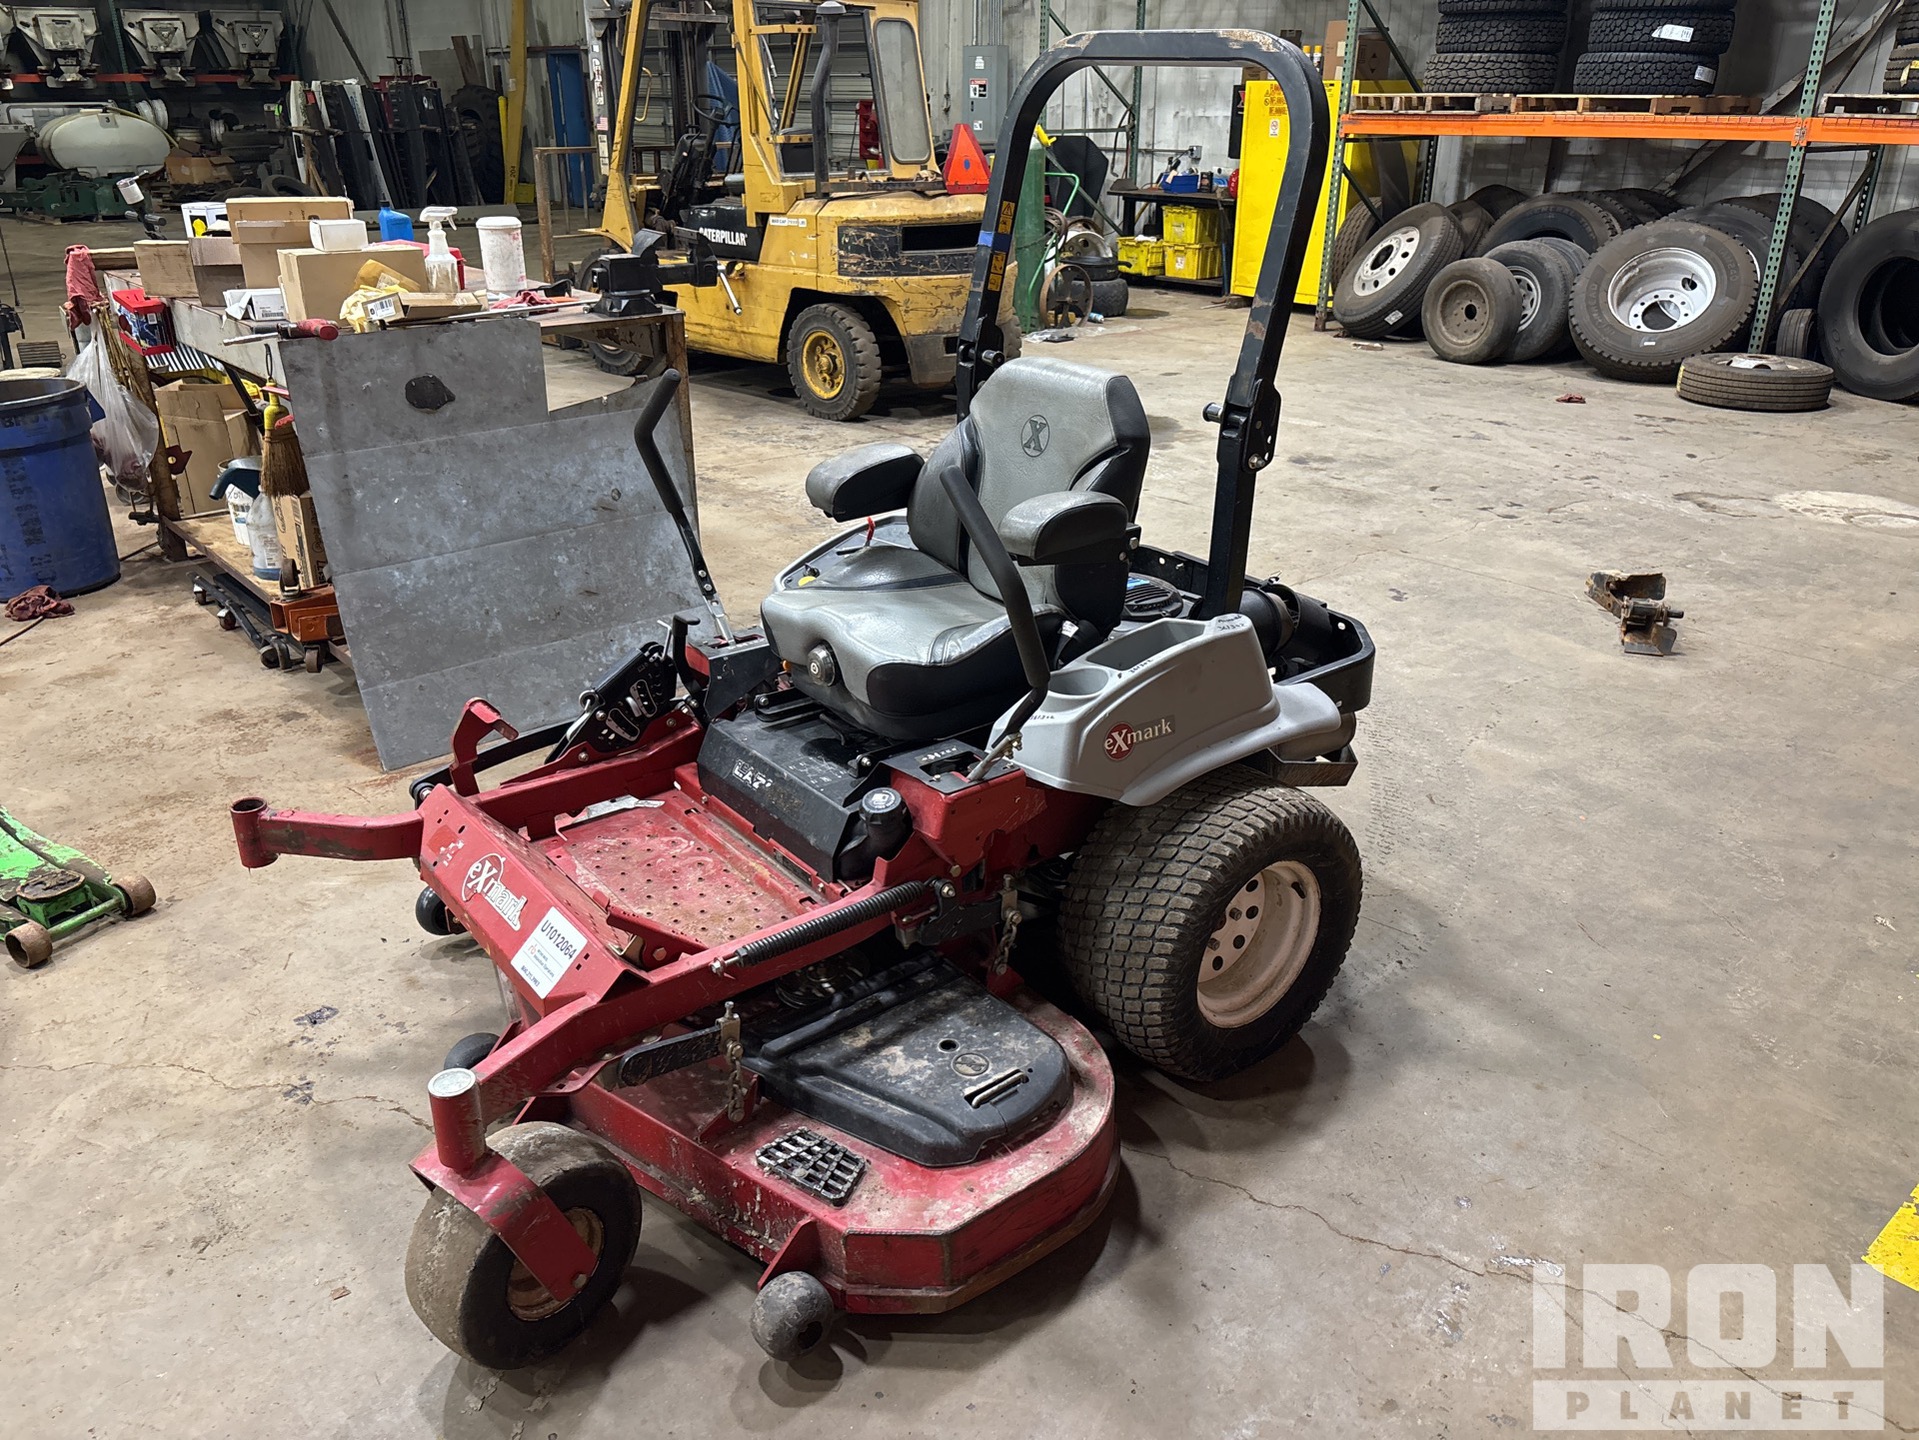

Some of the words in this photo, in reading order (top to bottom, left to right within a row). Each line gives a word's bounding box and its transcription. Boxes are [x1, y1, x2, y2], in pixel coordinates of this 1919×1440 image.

[699, 227, 747, 247] CATERPILLAR
[1104, 719, 1173, 755] eXmark
[466, 858, 526, 930] eXmark
[541, 920, 578, 960] U1012064
